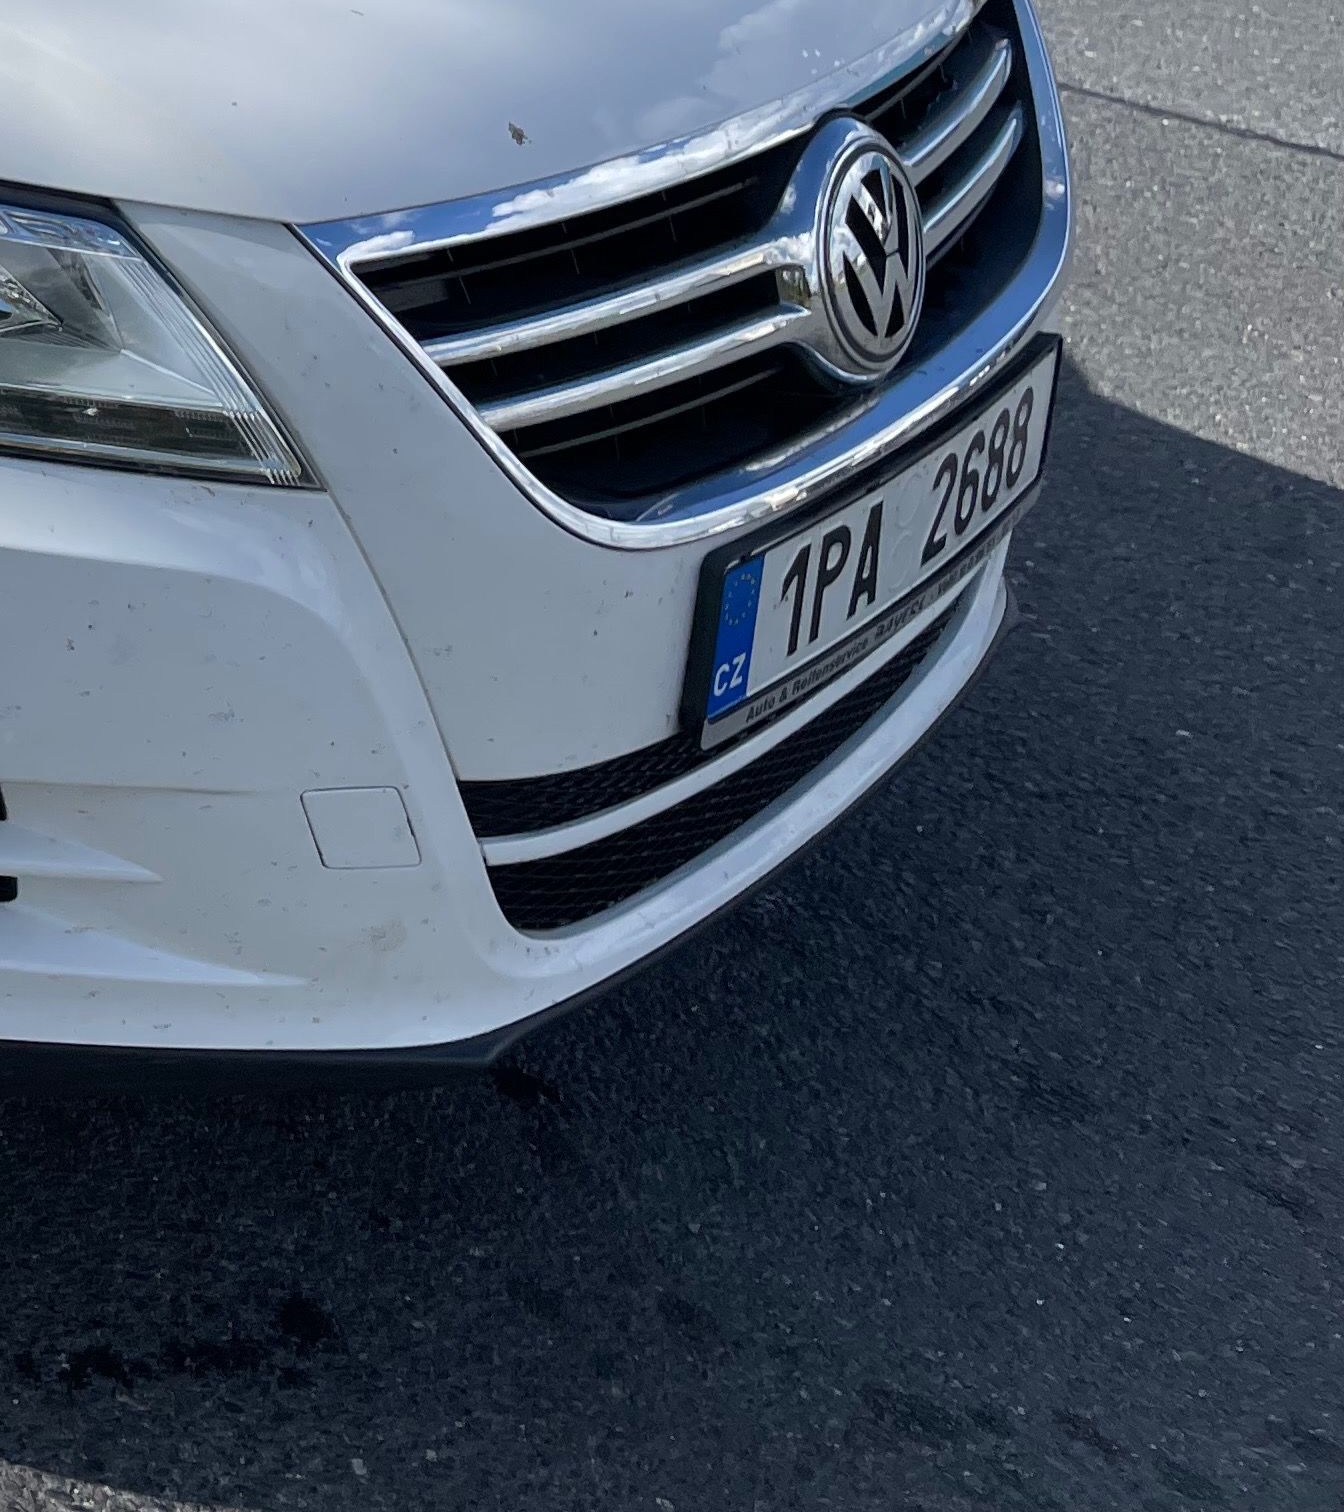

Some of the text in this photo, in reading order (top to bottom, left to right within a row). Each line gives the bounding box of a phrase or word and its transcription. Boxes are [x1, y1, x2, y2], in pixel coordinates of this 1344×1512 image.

[779, 498, 885, 657] 1PA
[919, 386, 1035, 569] 2688
[713, 652, 747, 697] CZ
[745, 696, 776, 723] Auto
[777, 689, 789, 704] &
